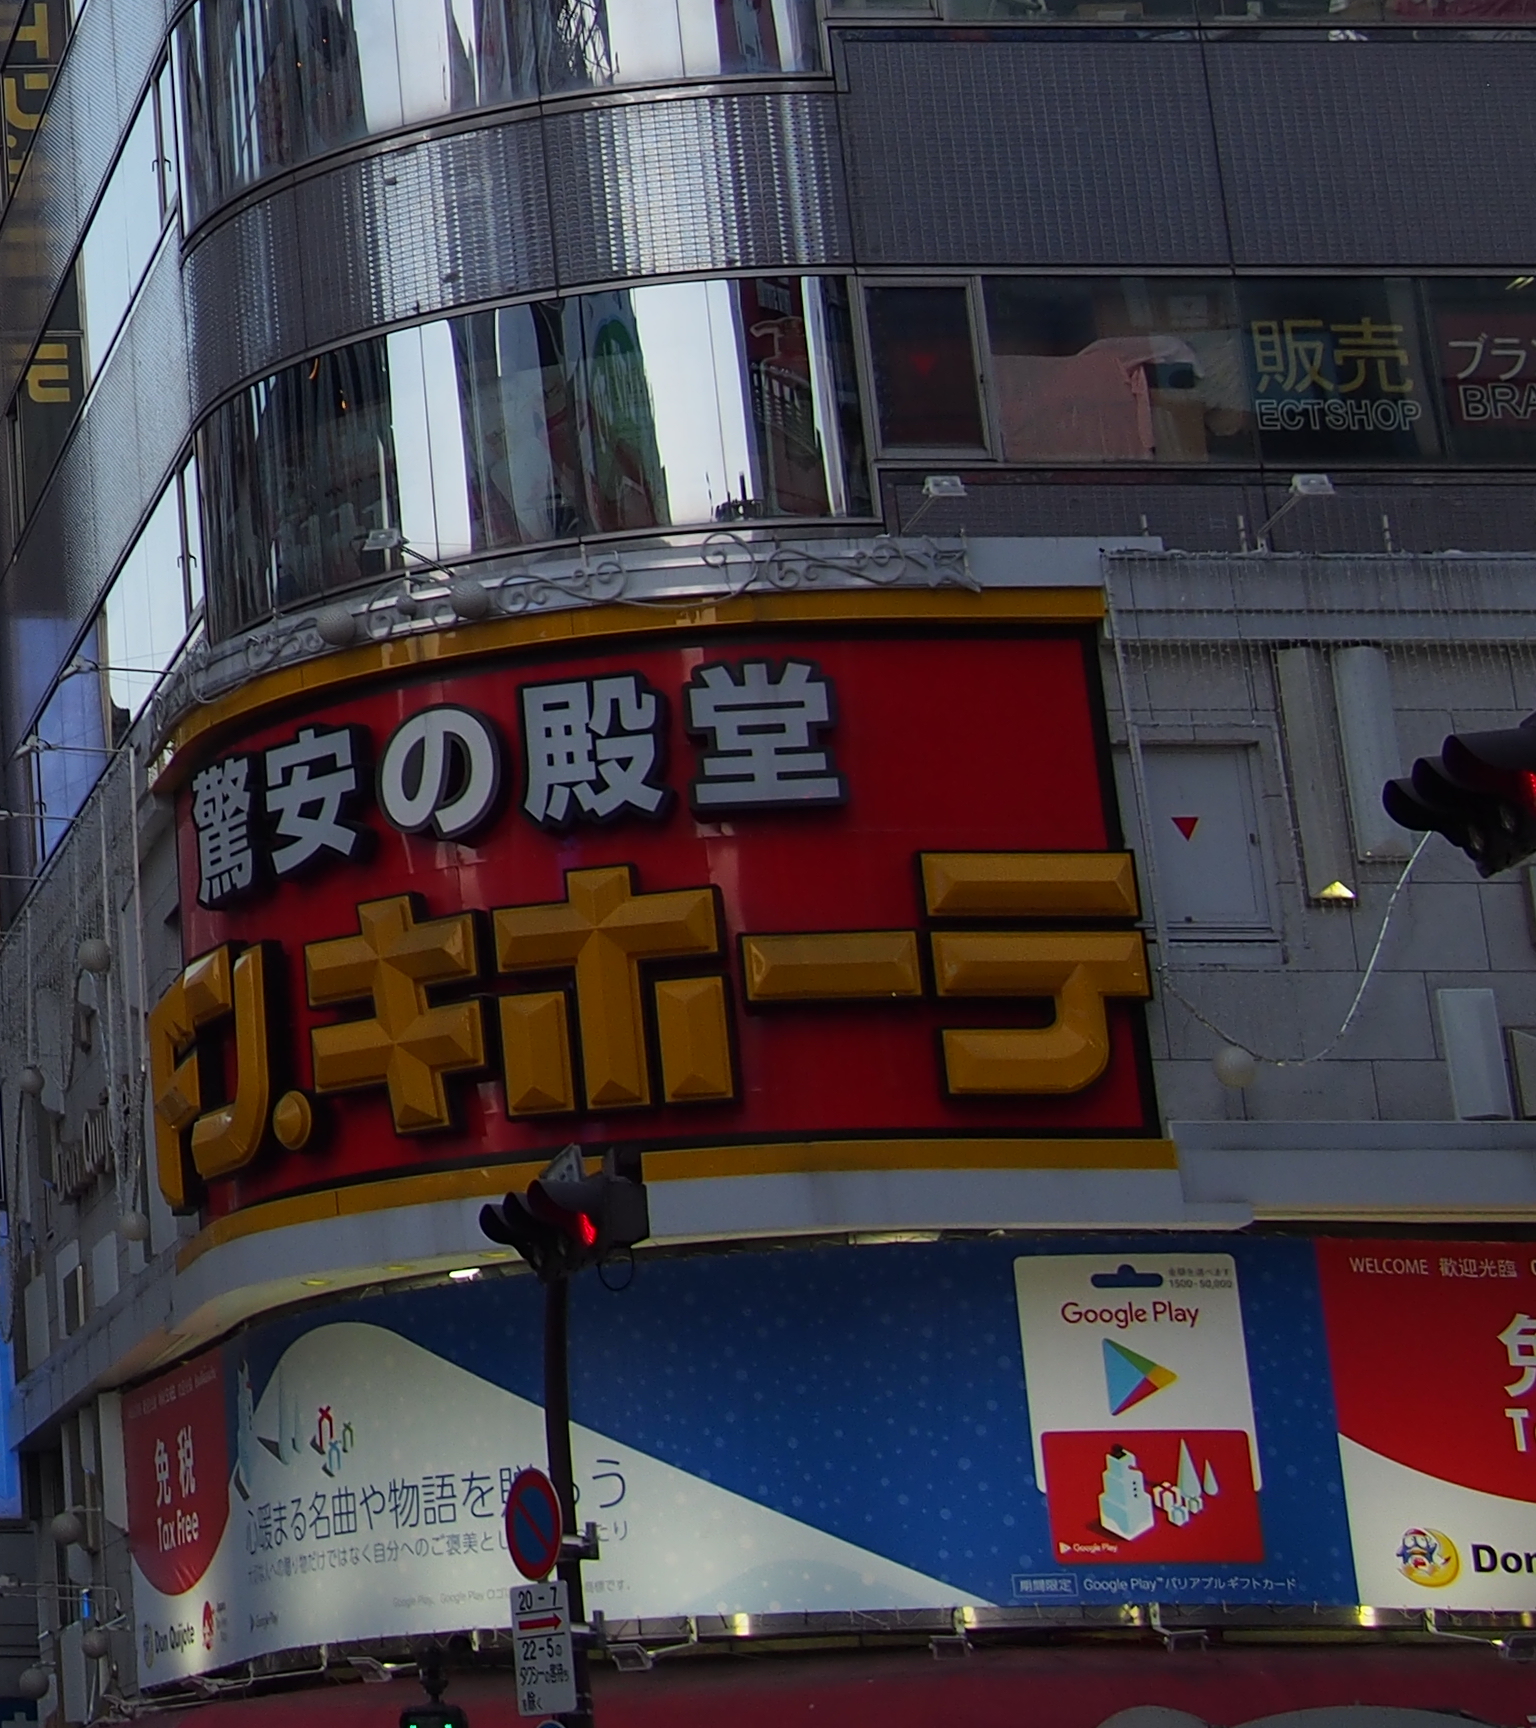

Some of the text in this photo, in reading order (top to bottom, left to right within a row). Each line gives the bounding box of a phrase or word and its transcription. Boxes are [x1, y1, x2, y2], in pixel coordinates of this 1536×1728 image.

[1251, 317, 1413, 394] 販売
[1258, 399, 1423, 431] ECTSHOP
[190, 660, 848, 910] 驚安の殿堂
[1349, 1256, 1429, 1275] WELCOME
[1061, 1301, 1199, 1328] Google Play
[154, 1425, 196, 1508] 免税
[157, 1509, 199, 1553] Tax Free
[1083, 1577, 1127, 1592] Google
[154, 1629, 169, 1654] Don
